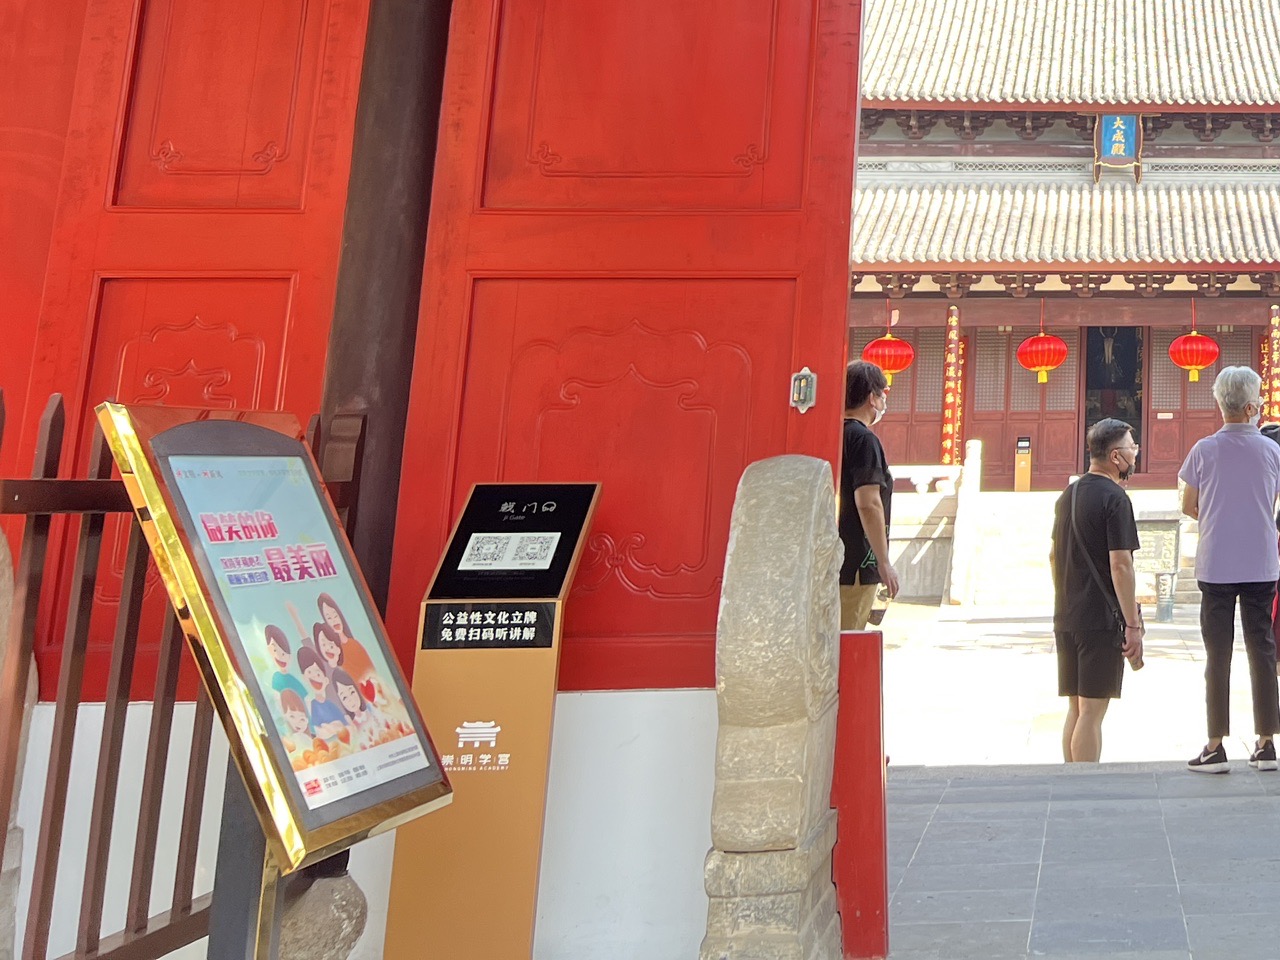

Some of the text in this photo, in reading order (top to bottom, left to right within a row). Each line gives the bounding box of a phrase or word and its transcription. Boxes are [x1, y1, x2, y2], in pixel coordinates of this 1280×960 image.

[1111, 116, 1126, 156] 大成殿
[200, 510, 278, 542] 微笑的你
[264, 543, 338, 582] 最美丽
[440, 627, 536, 641] 免费扫码听讲解
[442, 611, 537, 625] 公益性文化立牌
